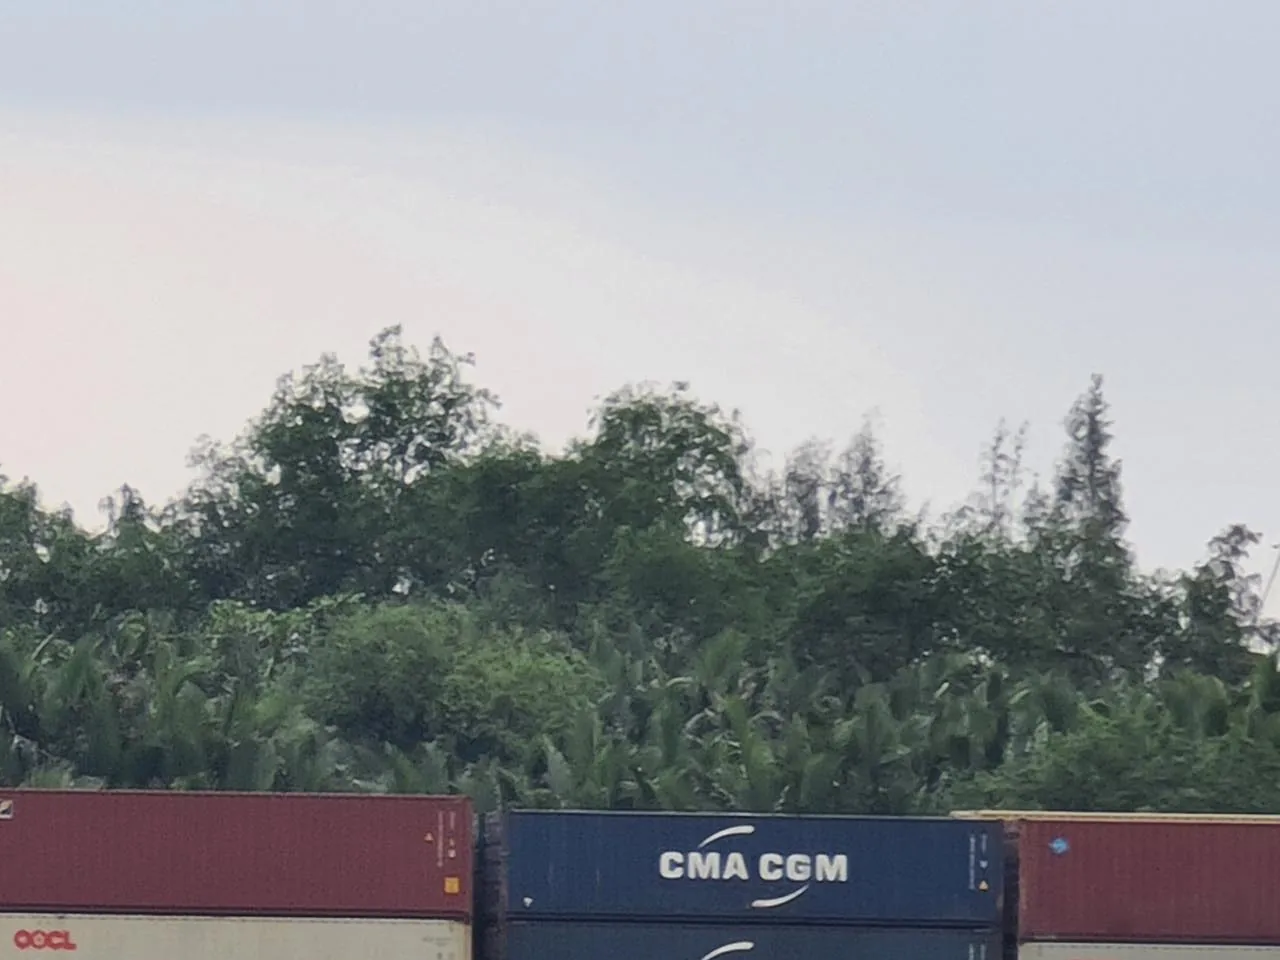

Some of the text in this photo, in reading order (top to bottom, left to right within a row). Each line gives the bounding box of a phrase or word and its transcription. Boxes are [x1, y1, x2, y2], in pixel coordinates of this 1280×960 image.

[659, 851, 848, 882] CMA CGM
[14, 930, 77, 950] OOCL
